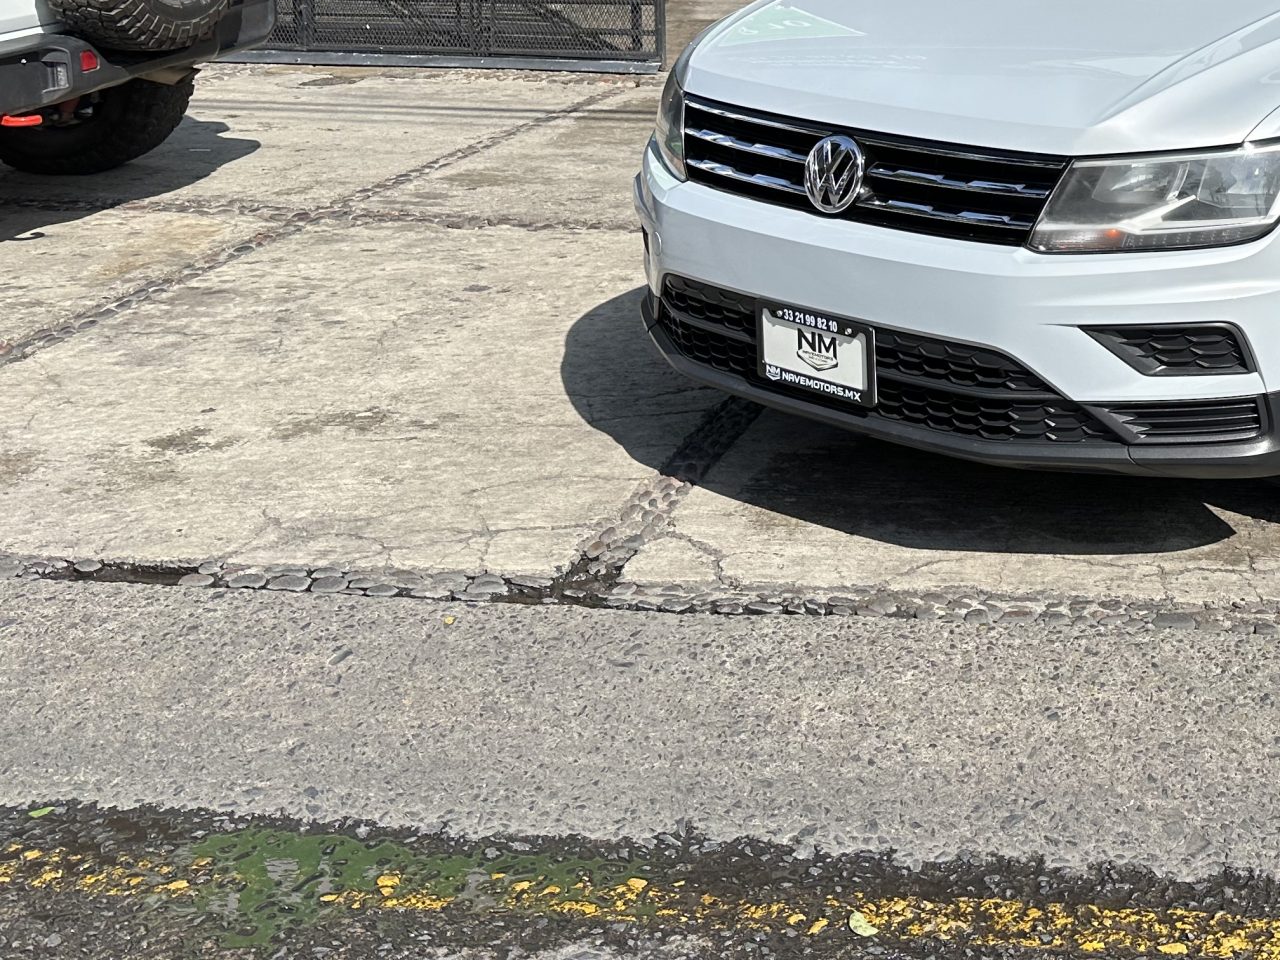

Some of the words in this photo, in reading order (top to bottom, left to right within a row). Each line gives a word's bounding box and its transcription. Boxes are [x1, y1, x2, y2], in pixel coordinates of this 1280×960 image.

[783, 308, 794, 321] 33
[795, 311, 804, 324] 21
[805, 314, 816, 327] 99
[817, 317, 828, 330] 82
[829, 320, 838, 333] 10
[797, 327, 838, 361] NM
[782, 371, 862, 403] NAVEMOTORS.MX
